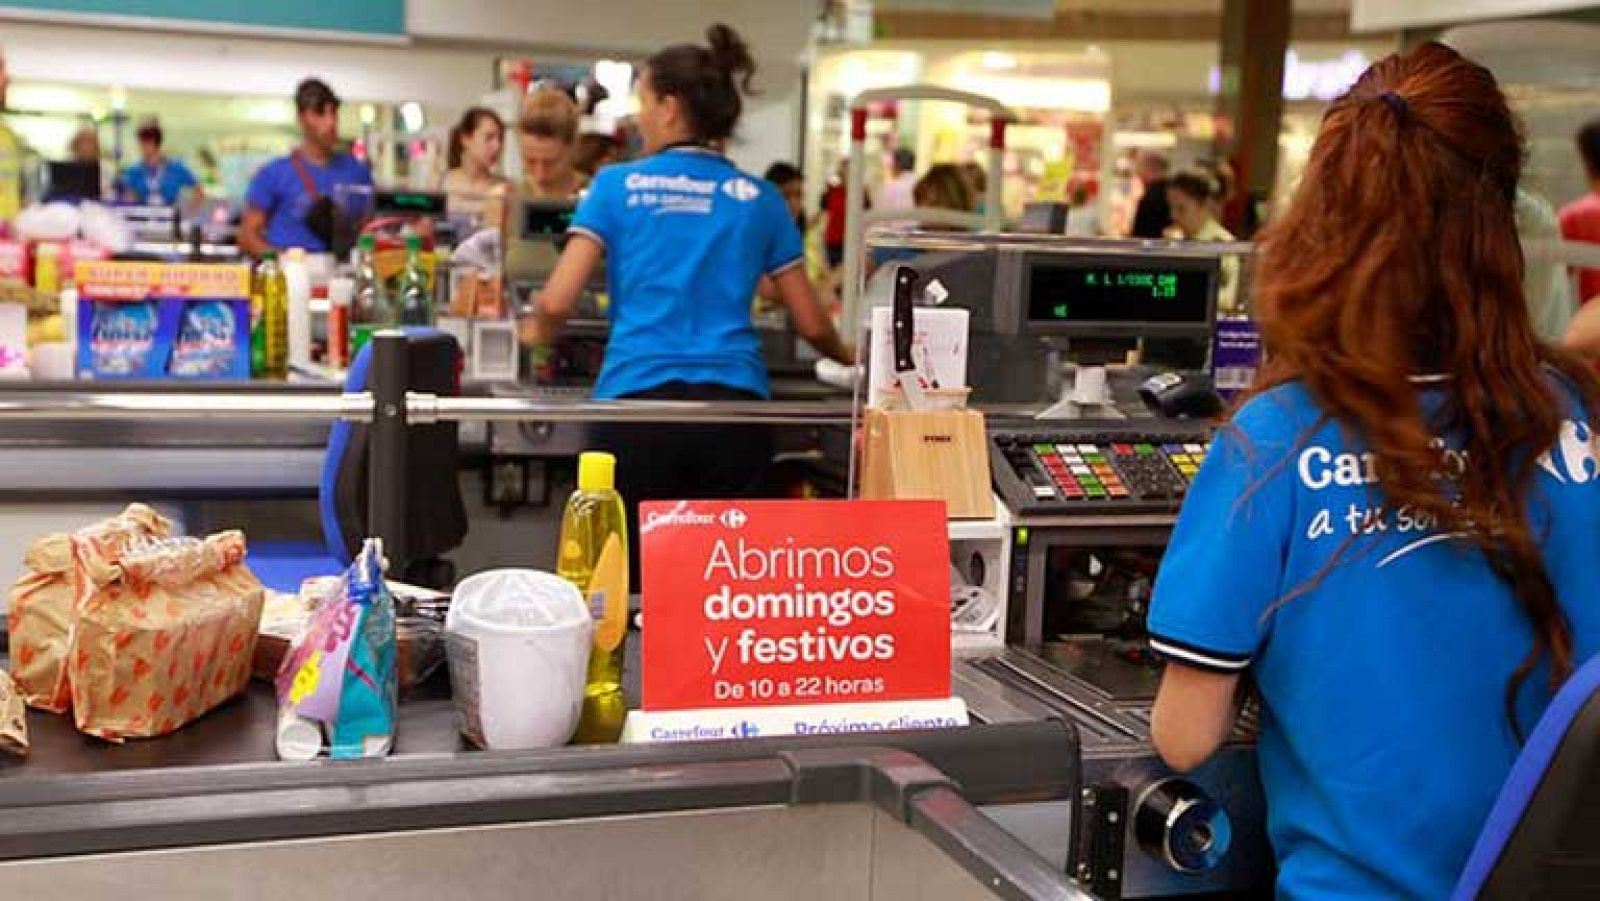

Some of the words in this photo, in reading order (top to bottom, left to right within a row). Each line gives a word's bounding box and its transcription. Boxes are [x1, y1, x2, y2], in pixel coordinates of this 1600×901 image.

[703, 537, 895, 581] Abrimos
[703, 582, 896, 626] domingos
[704, 635, 729, 674] y
[736, 625, 896, 664] festivos
[714, 680, 744, 699] De
[750, 678, 774, 697] 10
[777, 681, 791, 696] a
[795, 676, 821, 696] 22
[824, 675, 884, 694] horas
